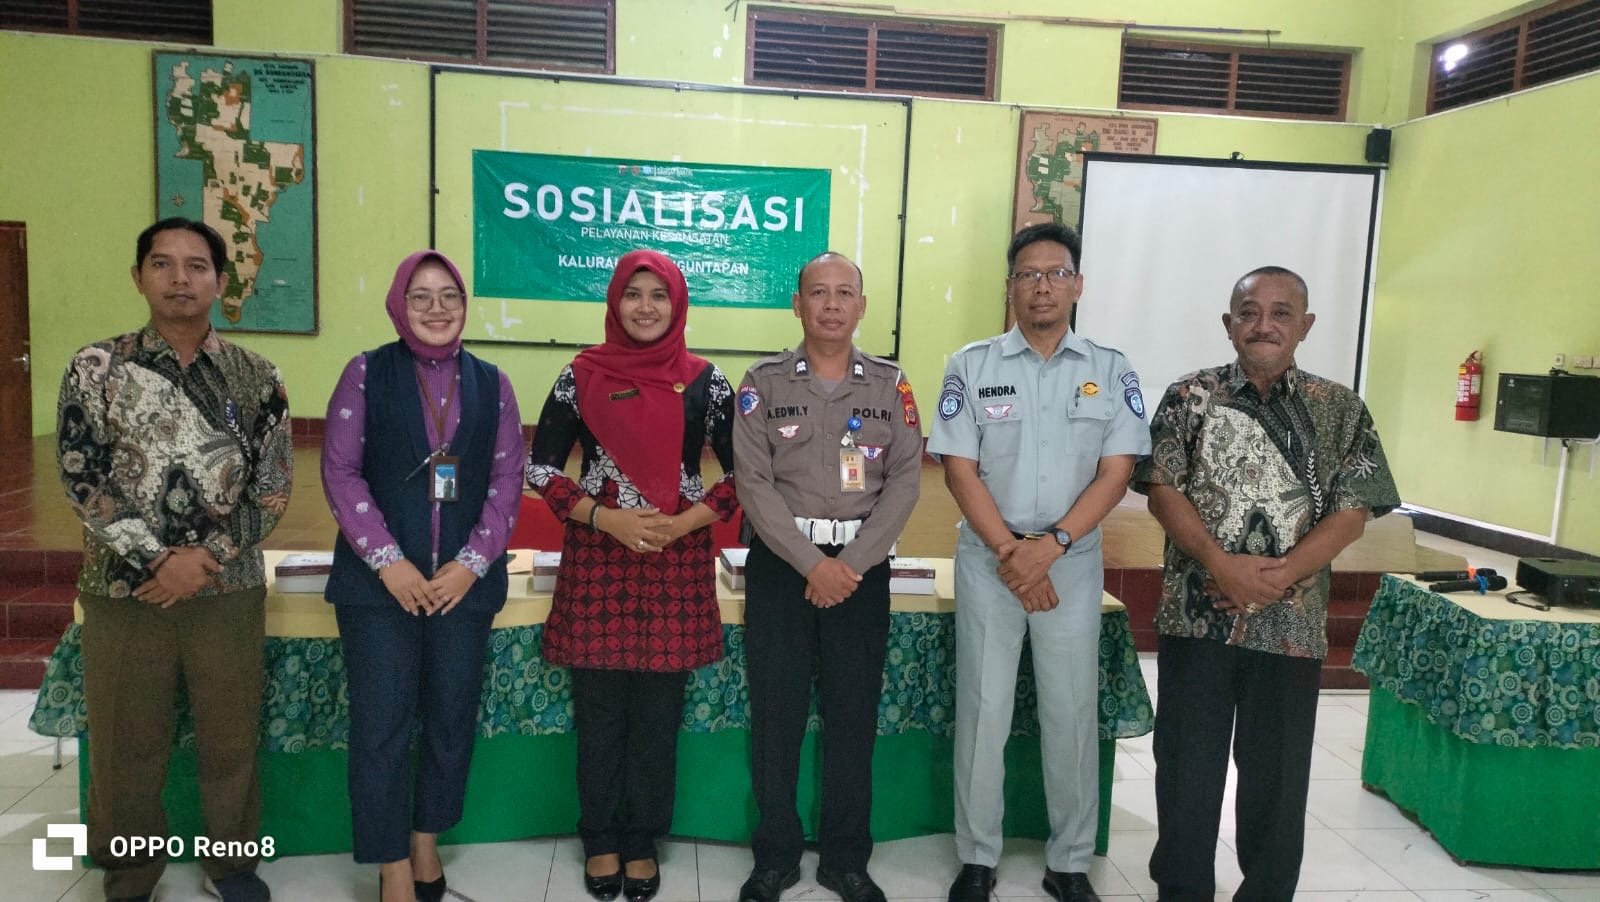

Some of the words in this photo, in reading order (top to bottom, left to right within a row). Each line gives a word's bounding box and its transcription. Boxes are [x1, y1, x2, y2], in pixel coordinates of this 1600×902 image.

[503, 182, 804, 232] SOSIALISASI
[581, 226, 649, 241] PELAYANAN
[978, 385, 1017, 399] HENDRA
[852, 407, 892, 422] POLRI
